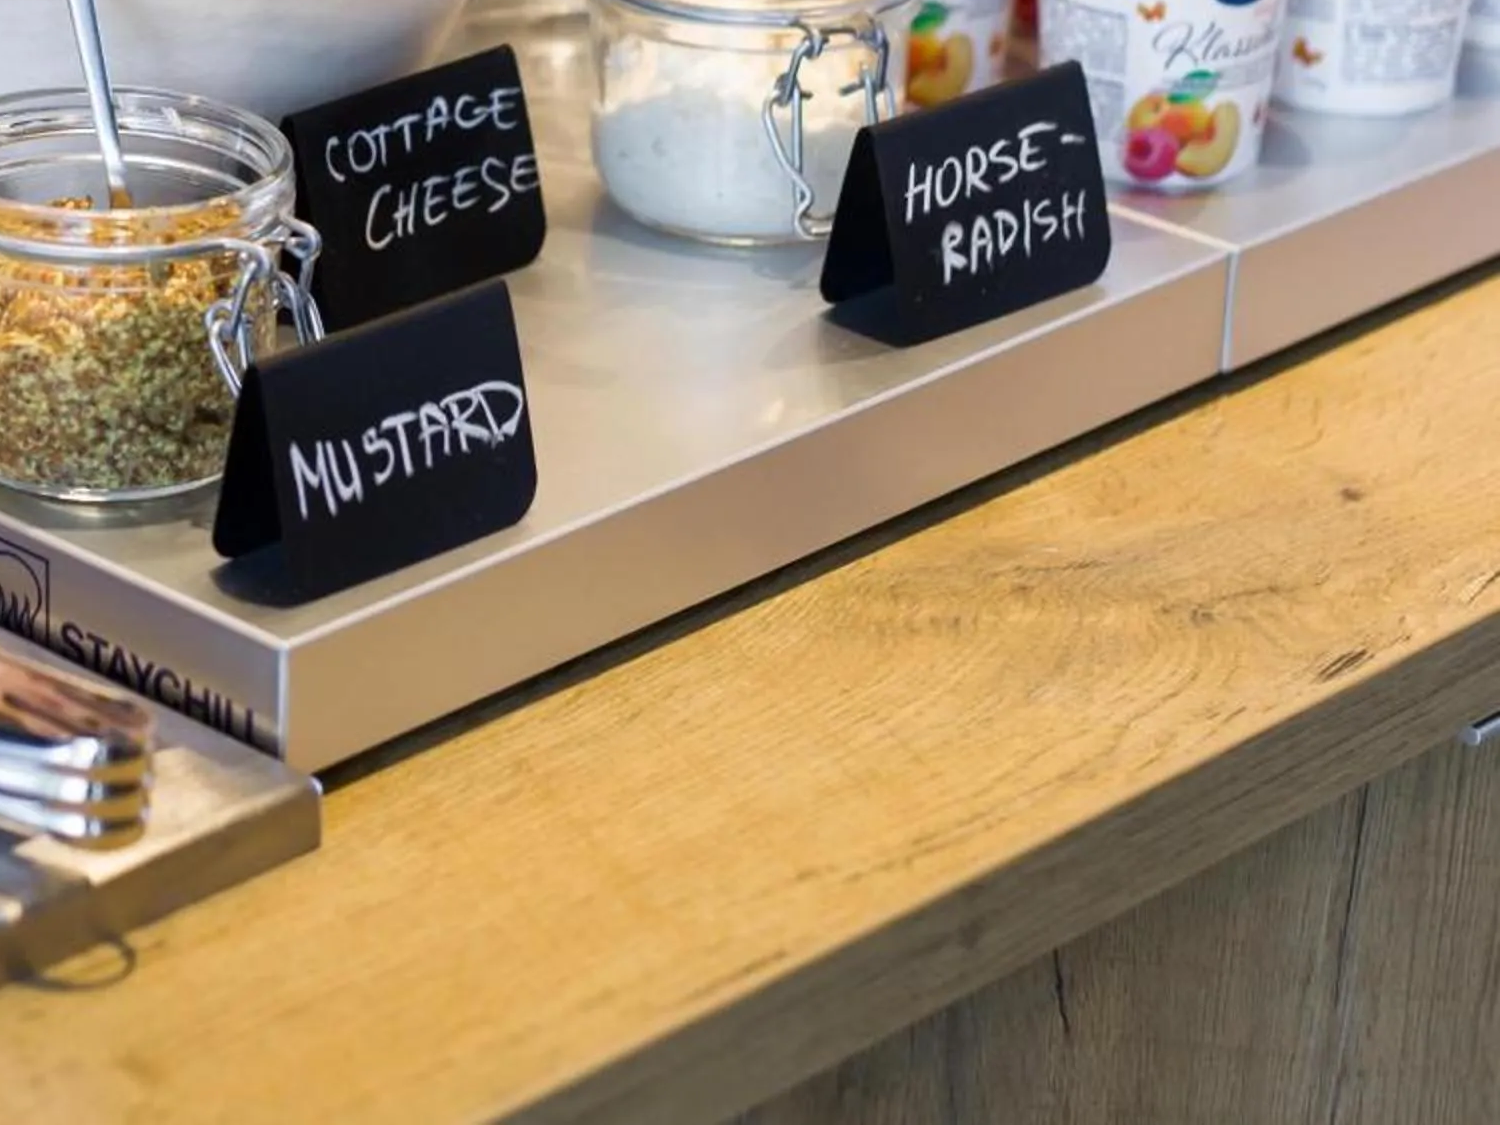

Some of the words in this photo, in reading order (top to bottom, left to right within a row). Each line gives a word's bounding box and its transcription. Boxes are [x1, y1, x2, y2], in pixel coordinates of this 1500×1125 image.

[324, 86, 521, 182] COTTAGE
[365, 153, 540, 251] CHEESE
[940, 188, 1086, 286] RADISH
[288, 380, 526, 521] MUSTARD
[60, 621, 256, 745] STAYCHILL
